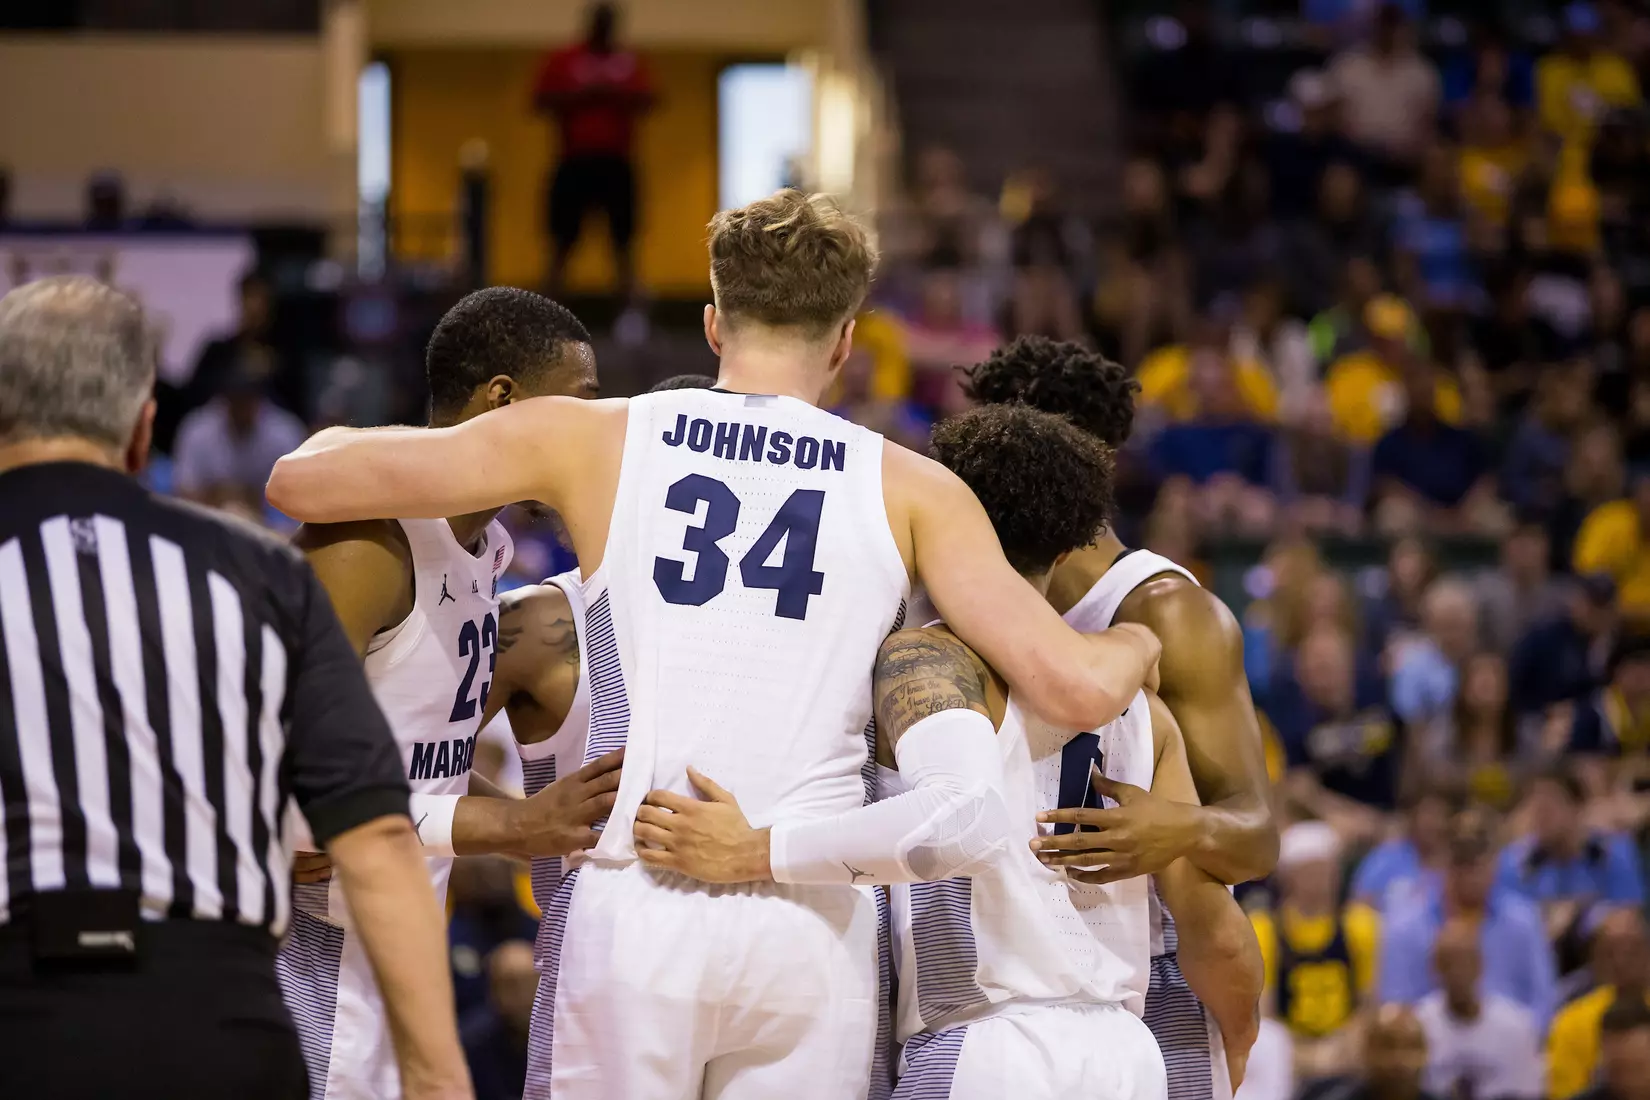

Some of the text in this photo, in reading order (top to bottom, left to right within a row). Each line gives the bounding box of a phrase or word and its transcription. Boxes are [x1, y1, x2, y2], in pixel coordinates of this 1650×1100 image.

[662, 413, 846, 472] JOHNSON
[653, 473, 826, 620] 34
[448, 611, 497, 723] 23
